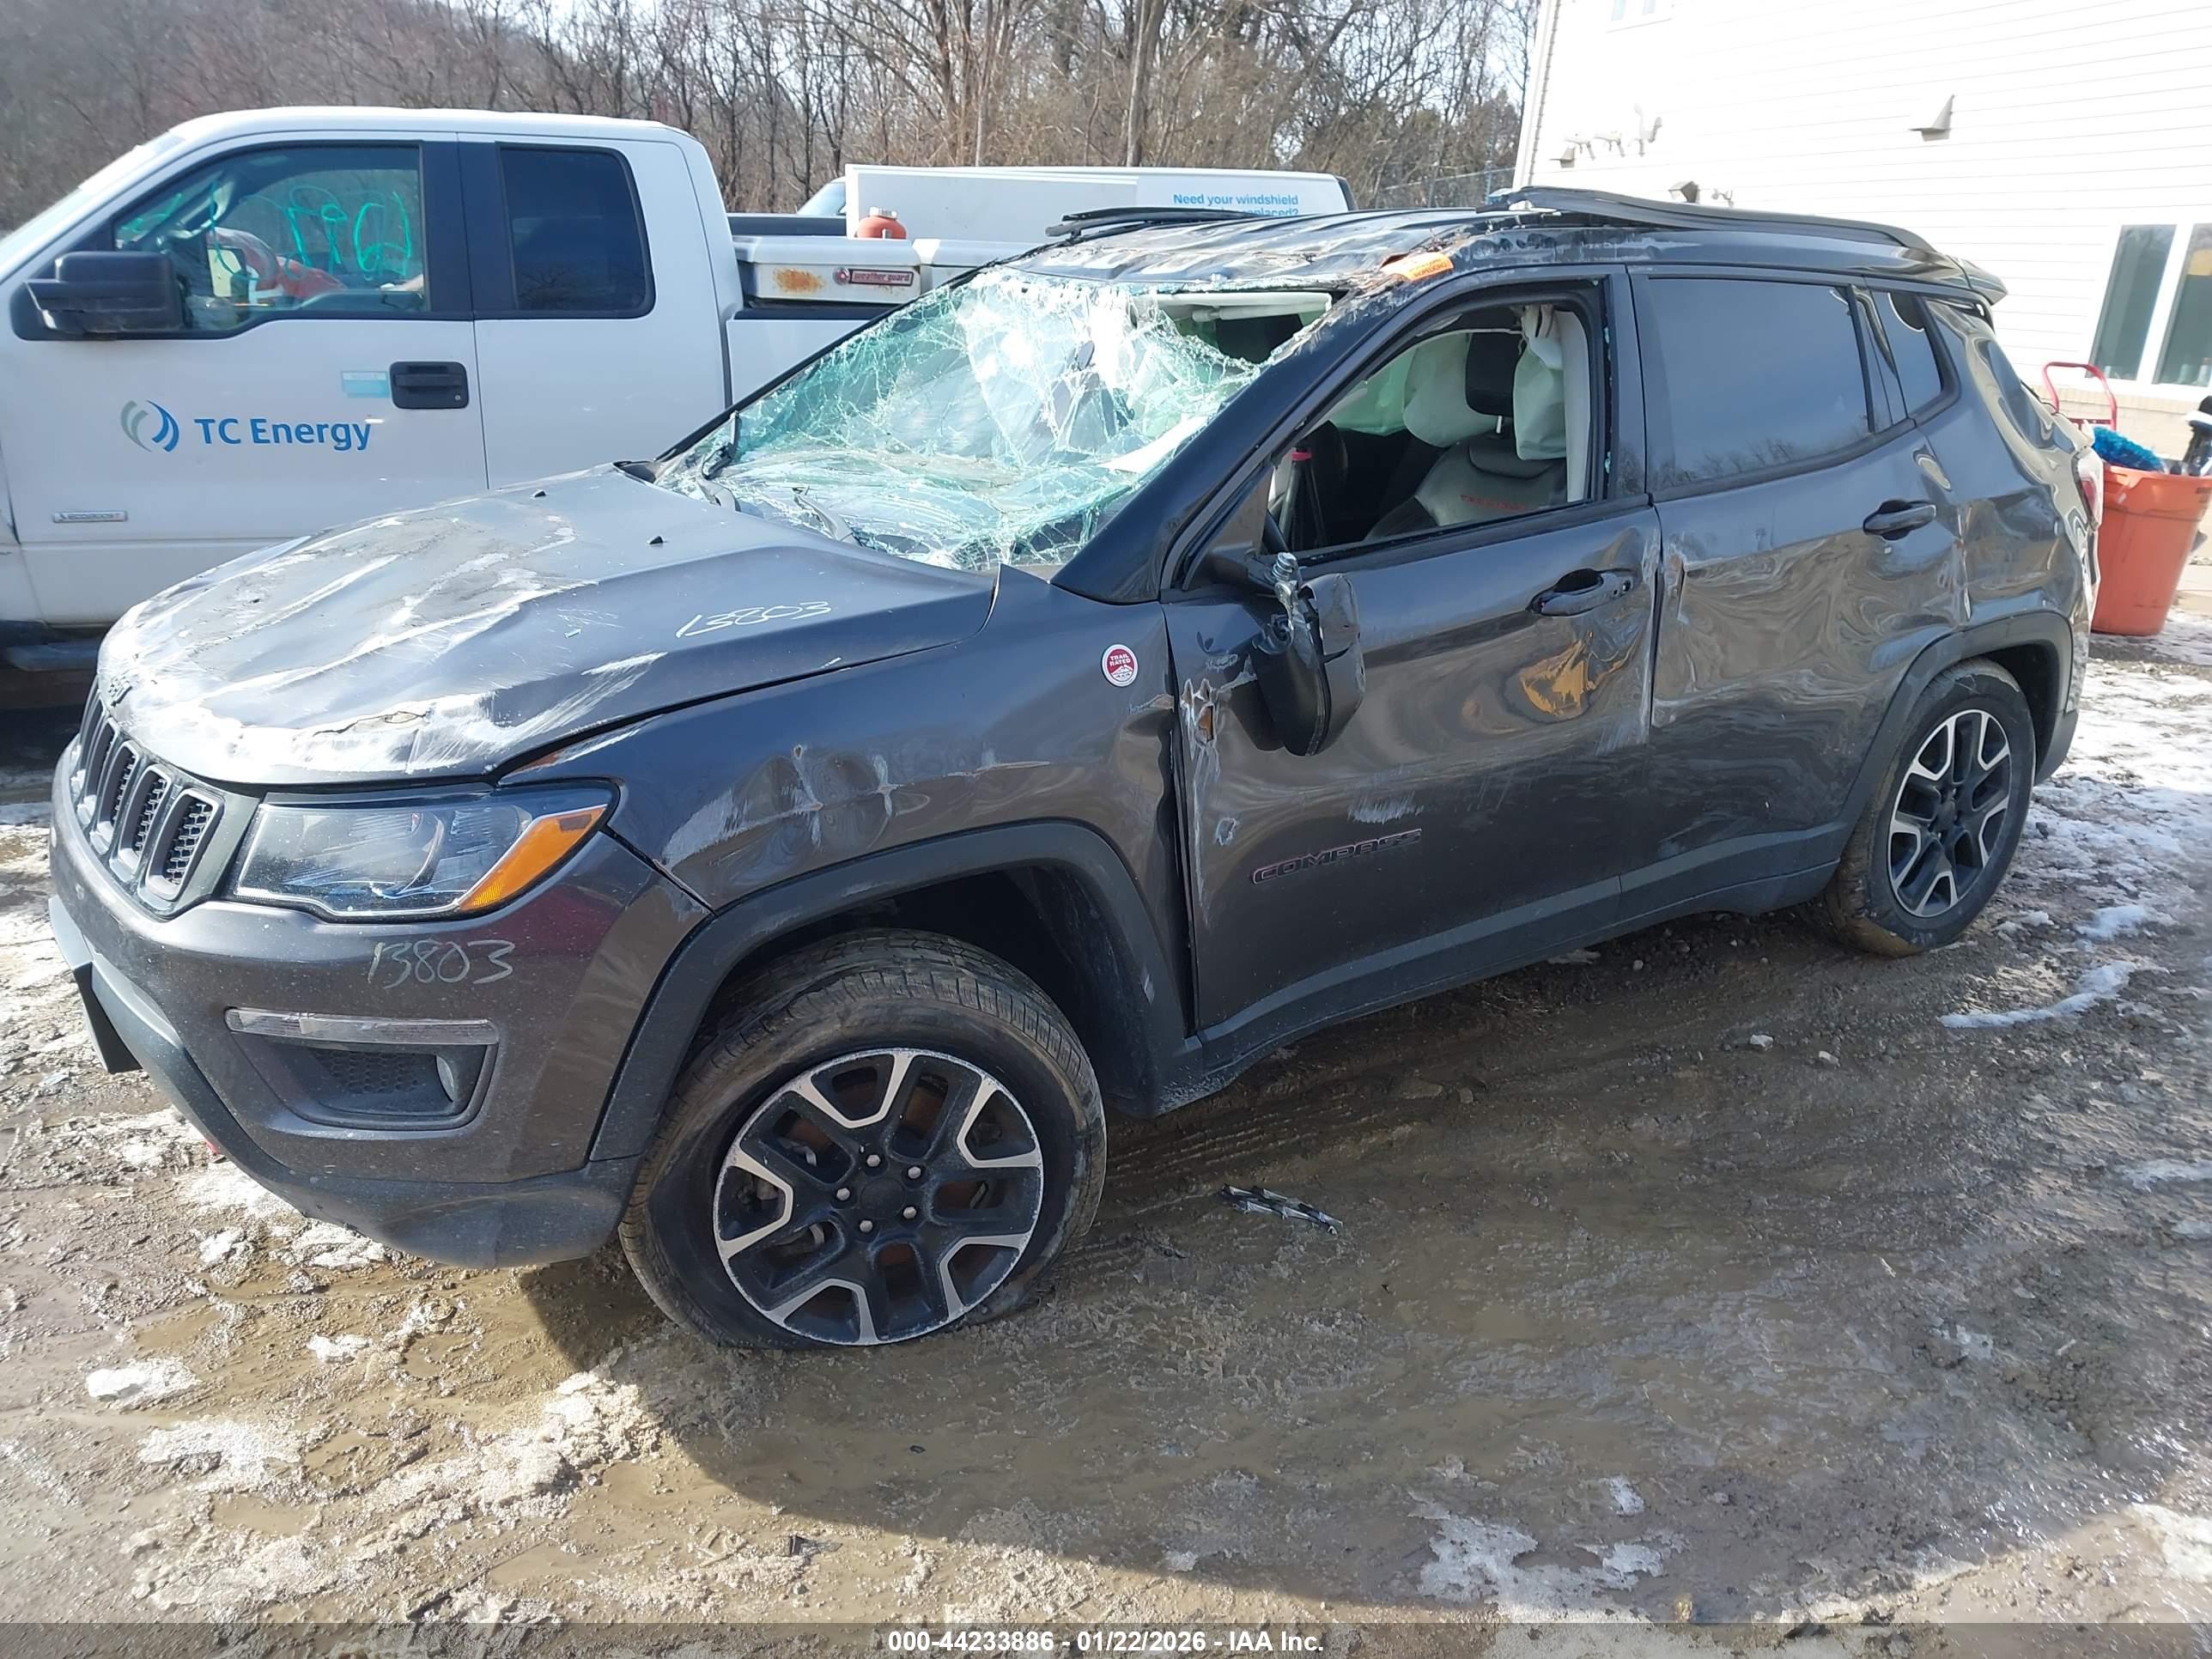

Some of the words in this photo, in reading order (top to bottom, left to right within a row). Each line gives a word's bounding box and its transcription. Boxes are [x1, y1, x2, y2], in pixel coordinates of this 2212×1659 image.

[1173, 194, 1204, 204] Need
[1207, 196, 1233, 206] your
[1236, 194, 1299, 205] windshield
[194, 418, 241, 444] TC
[250, 418, 371, 452] Energy
[675, 601, 832, 639] 13803
[1109, 658, 1131, 667] RATED
[1250, 828, 1422, 884] COMPASS
[368, 939, 515, 989] 13803
